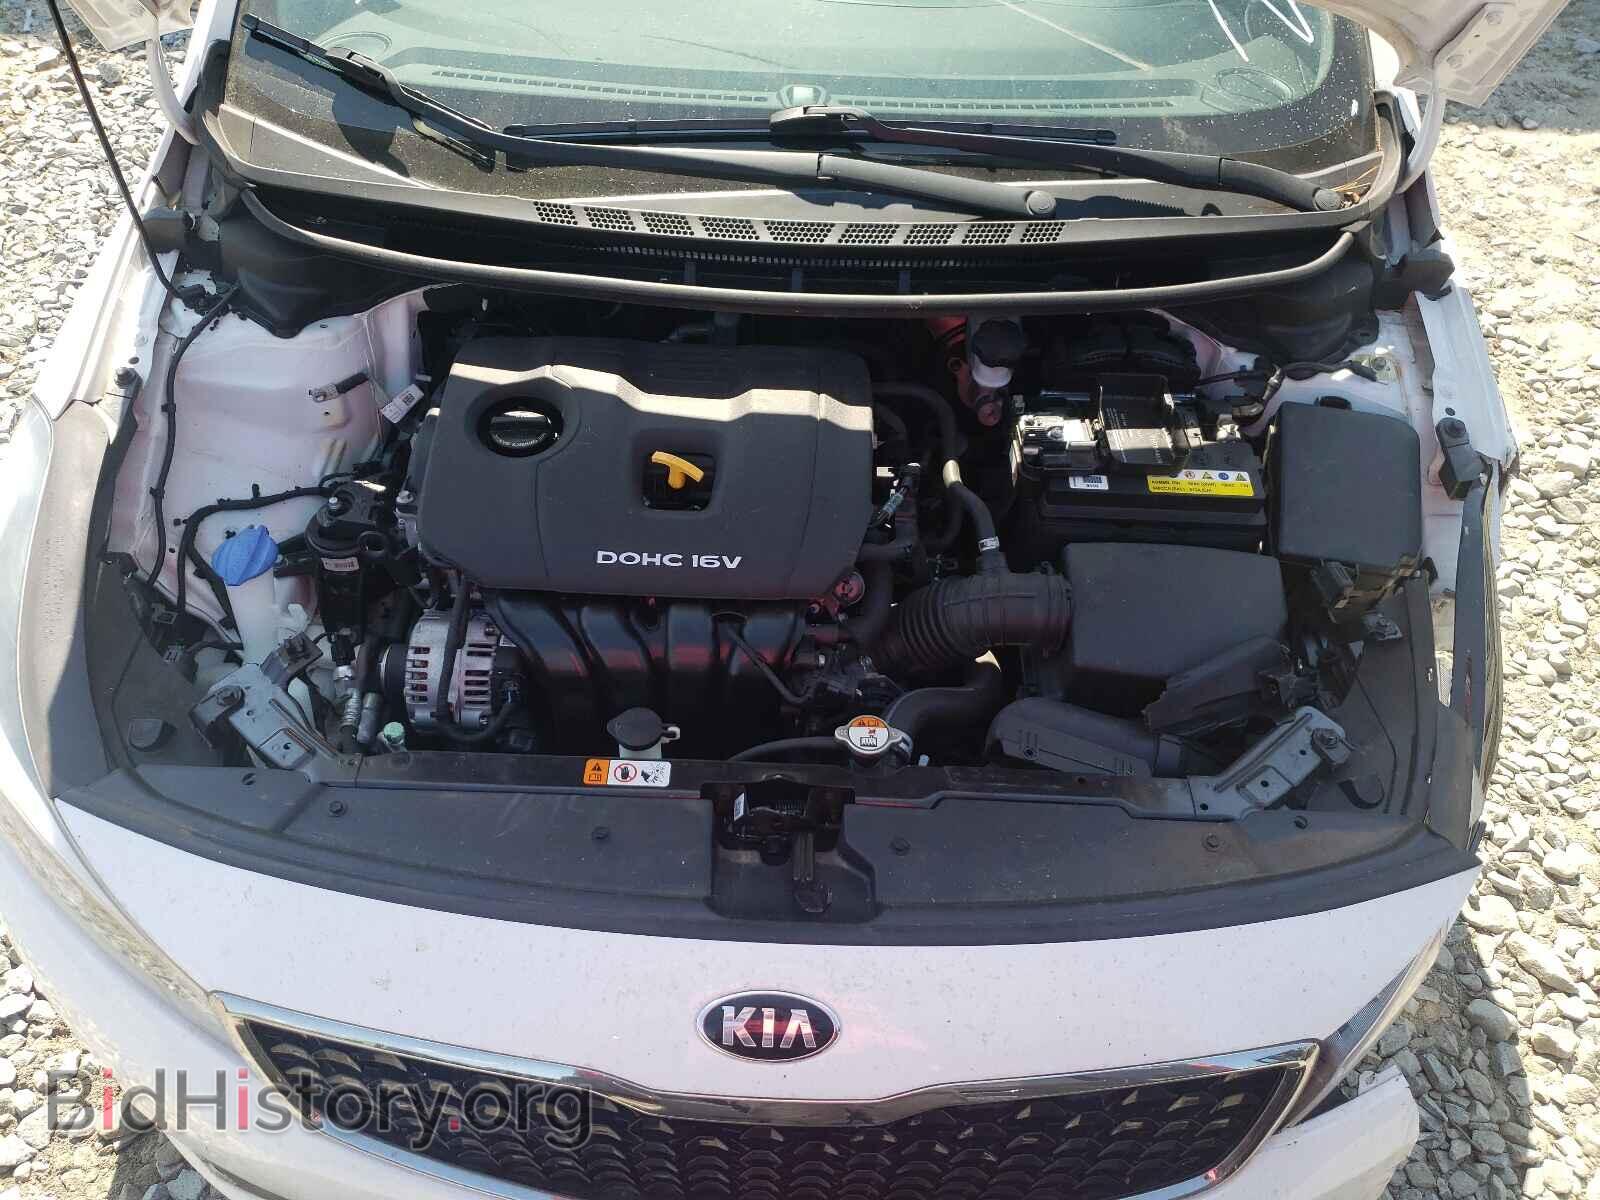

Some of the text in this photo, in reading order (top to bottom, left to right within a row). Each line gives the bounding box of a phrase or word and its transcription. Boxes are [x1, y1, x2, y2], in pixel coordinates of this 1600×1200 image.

[596, 550, 743, 569] DOHC 16V
[721, 1005, 817, 1049] KIA
